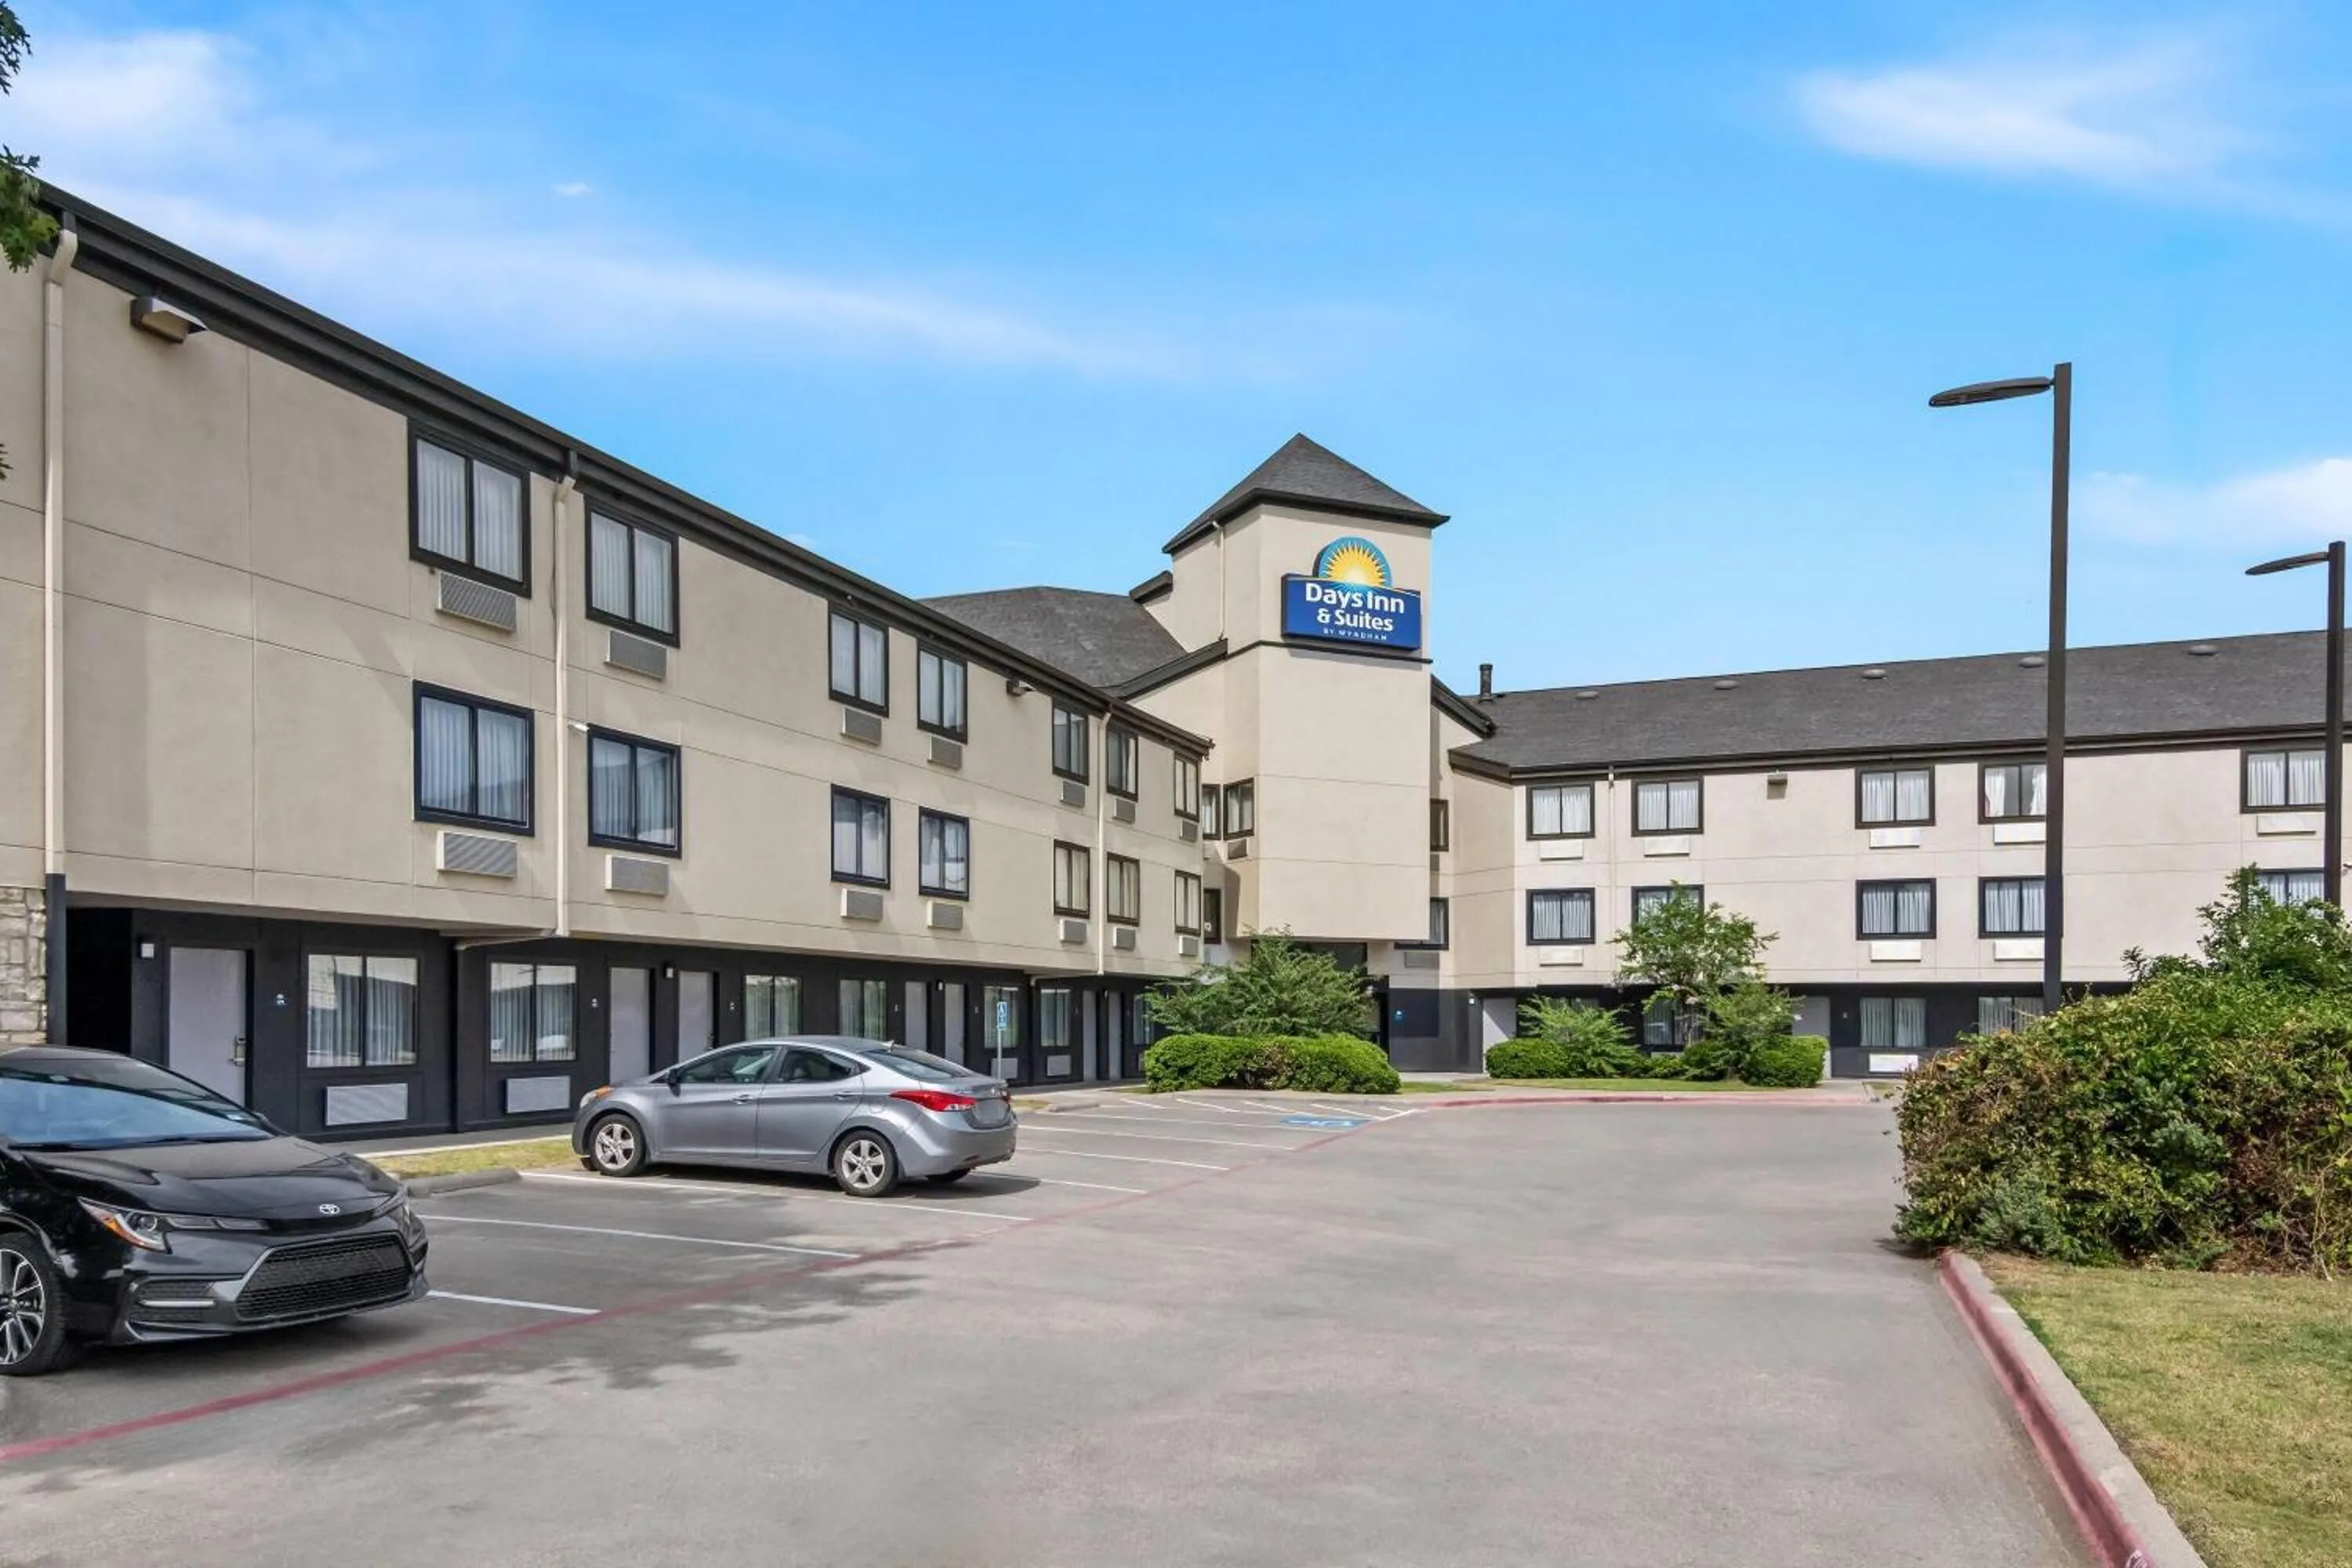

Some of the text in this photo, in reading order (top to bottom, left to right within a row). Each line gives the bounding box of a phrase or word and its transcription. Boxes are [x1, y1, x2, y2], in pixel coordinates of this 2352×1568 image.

[1305, 583, 1405, 614] Days Inn
[1316, 608, 1393, 631] & Suites
